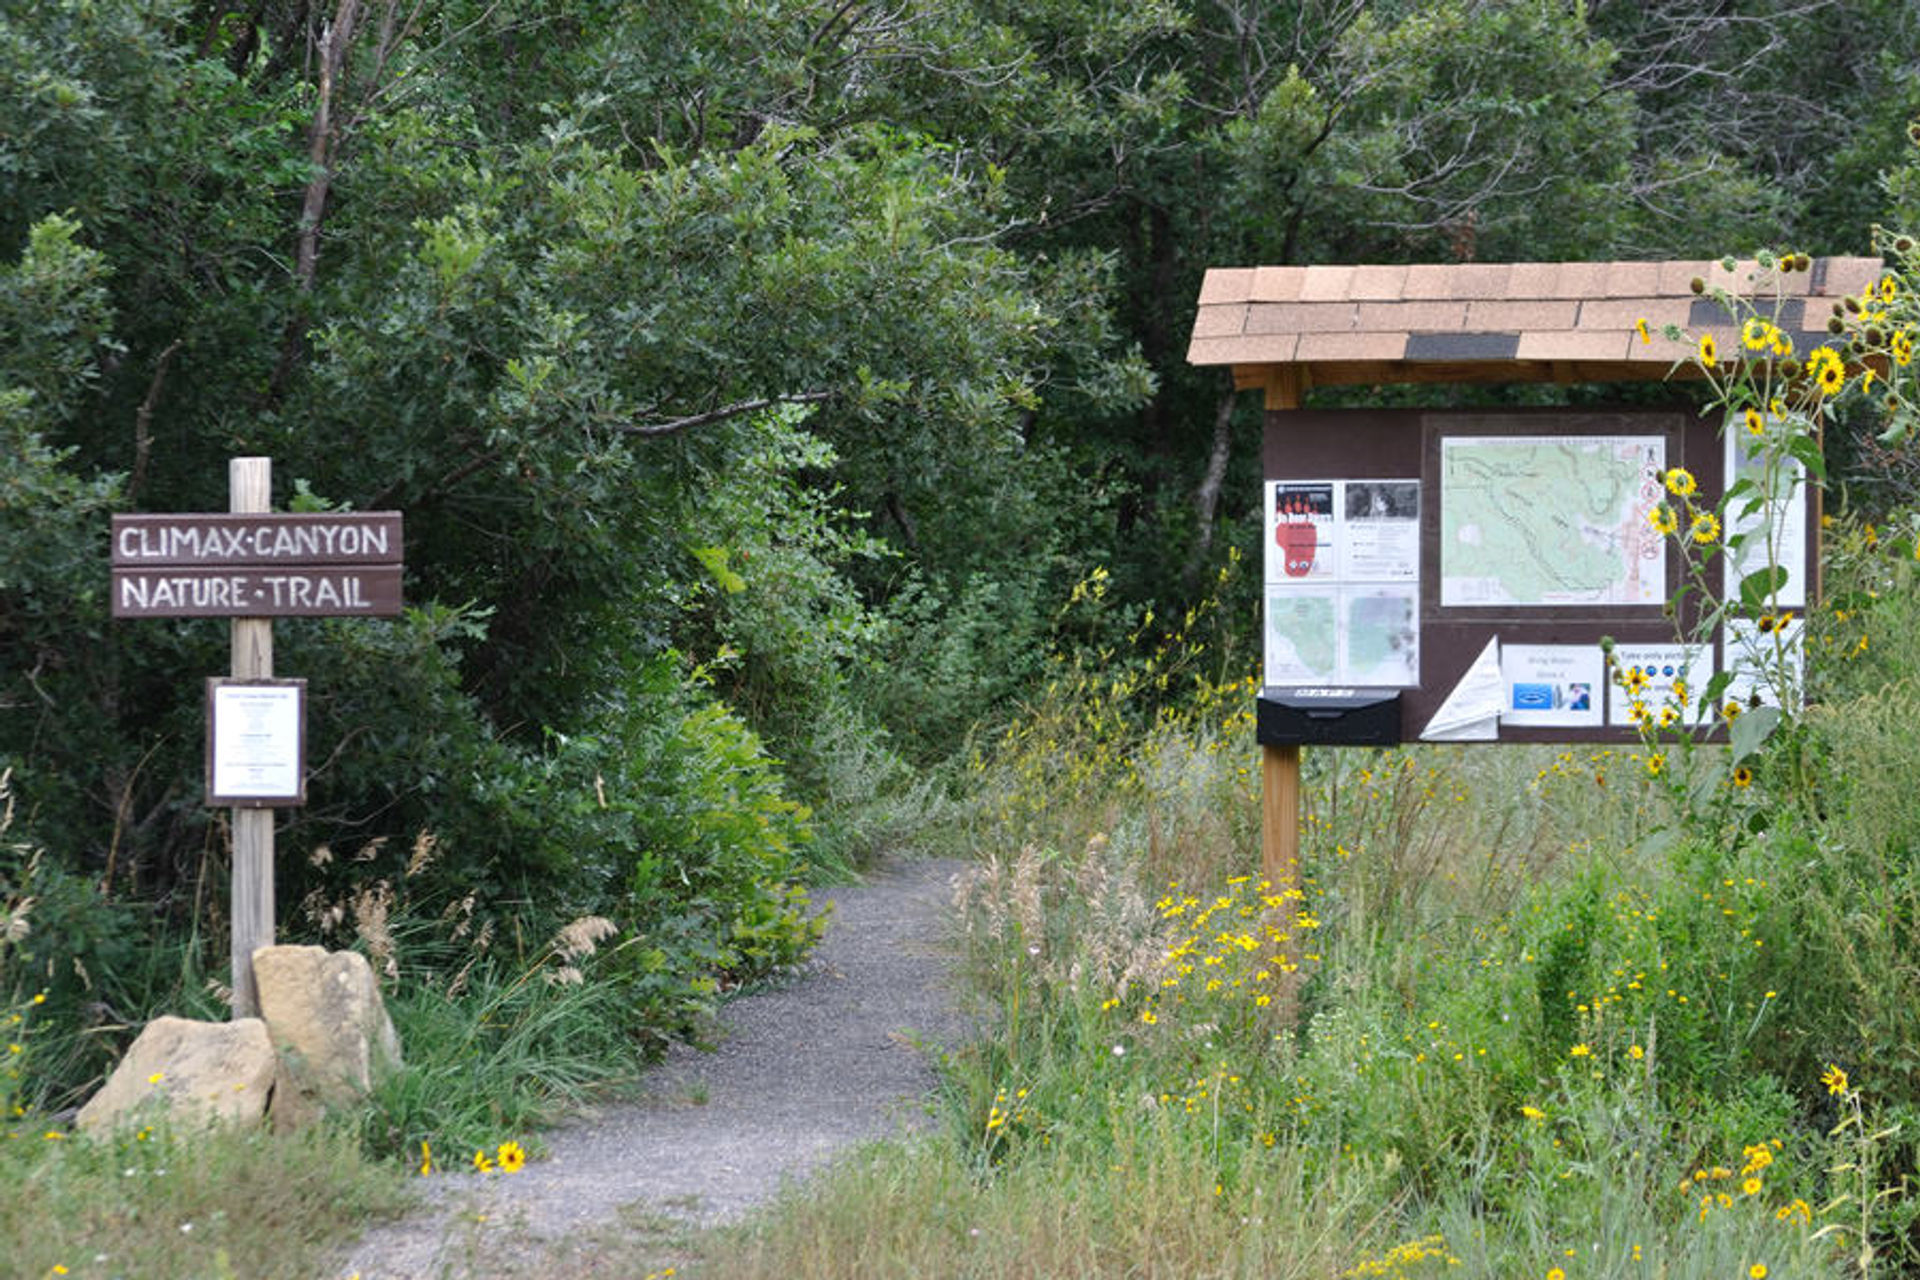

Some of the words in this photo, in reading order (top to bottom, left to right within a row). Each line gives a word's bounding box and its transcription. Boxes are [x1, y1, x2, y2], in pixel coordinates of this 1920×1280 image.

[119, 526, 247, 558] CLIMAX
[254, 525, 388, 556] CANYON
[121, 576, 249, 609] NATURE
[263, 576, 371, 608] TRAIL
